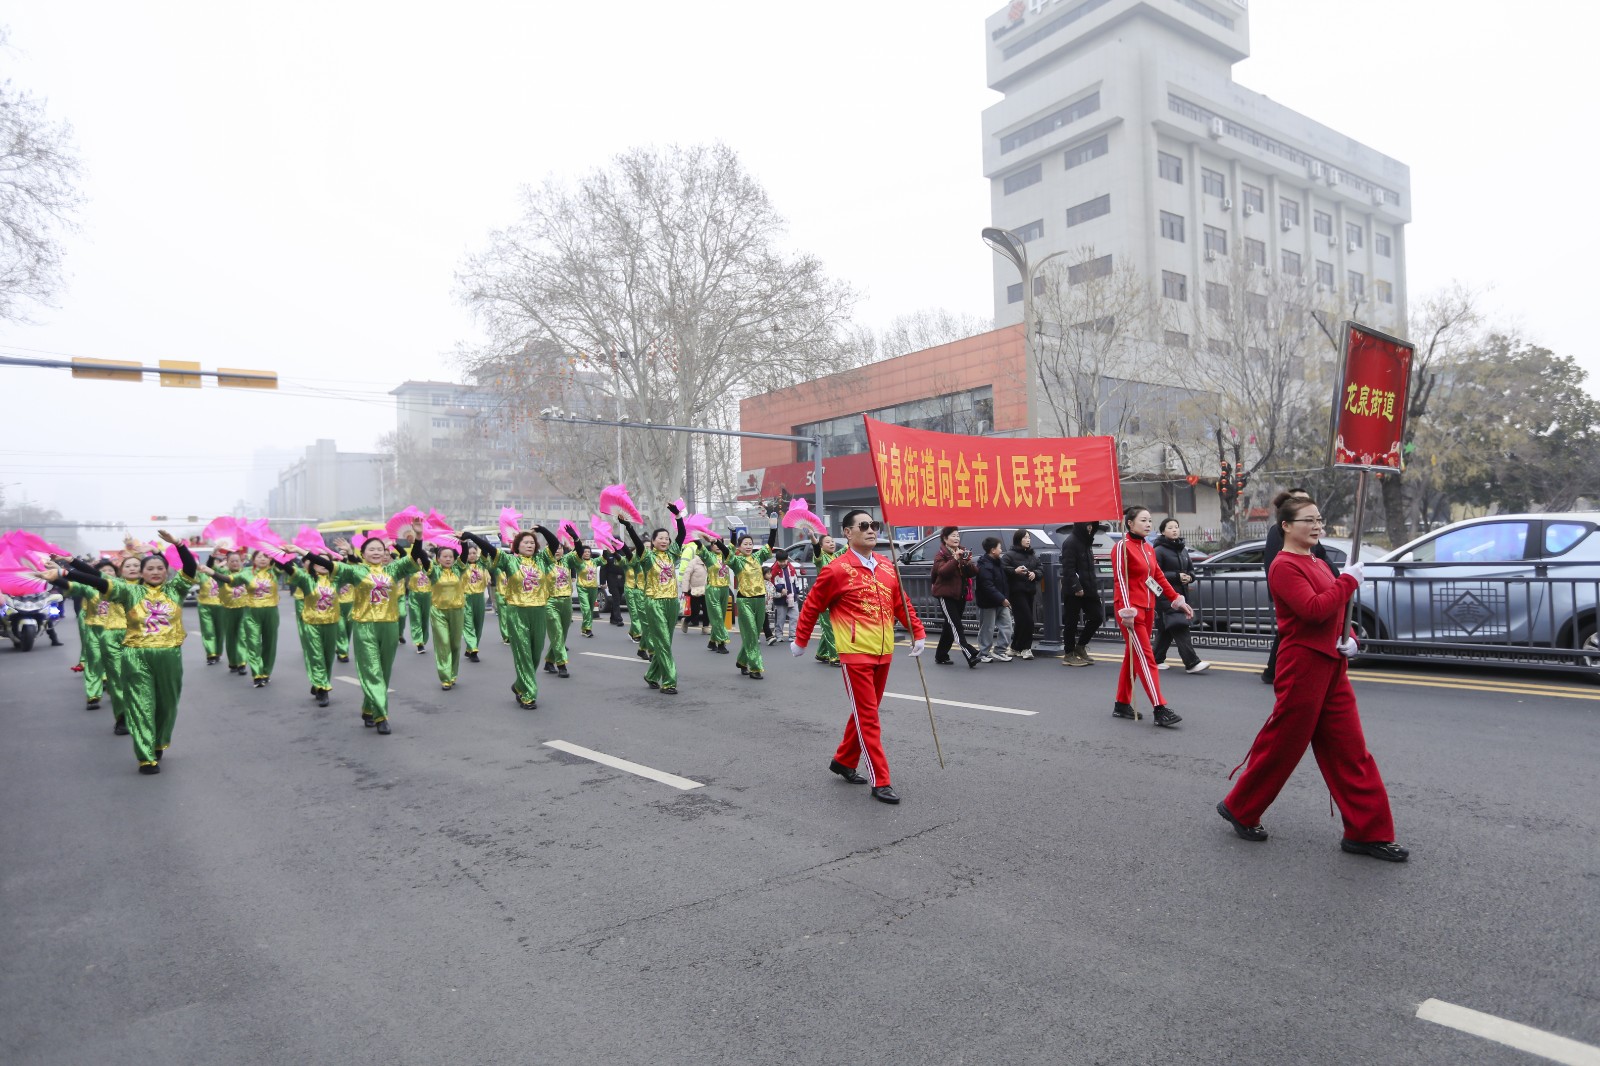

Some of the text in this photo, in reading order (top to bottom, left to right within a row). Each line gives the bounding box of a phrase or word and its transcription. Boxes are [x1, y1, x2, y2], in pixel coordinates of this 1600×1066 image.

[1345, 382, 1396, 422] 龙泉街道
[877, 439, 1080, 509] 龙泉街道向全市人民拜年
